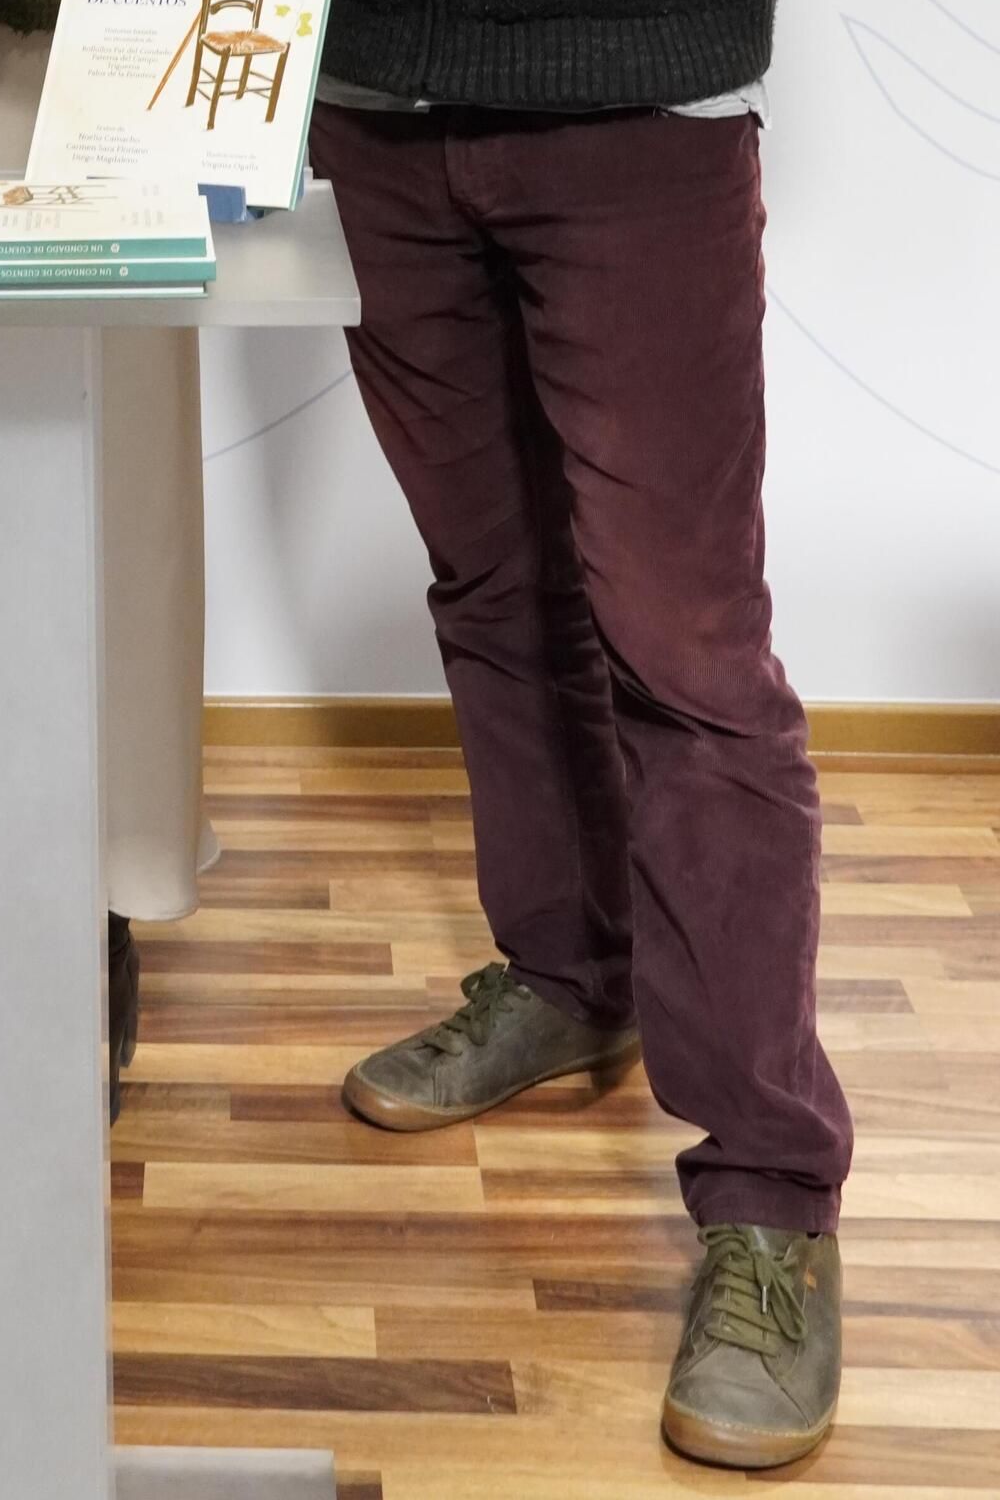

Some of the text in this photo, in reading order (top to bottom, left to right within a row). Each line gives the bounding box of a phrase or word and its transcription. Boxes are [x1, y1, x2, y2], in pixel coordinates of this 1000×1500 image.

[33, 245, 44, 254] DE
[46, 244, 89, 254] CONDADO
[90, 244, 103, 253] UN
[1, 267, 112, 278] UN CONDADO DE CUENTOS
